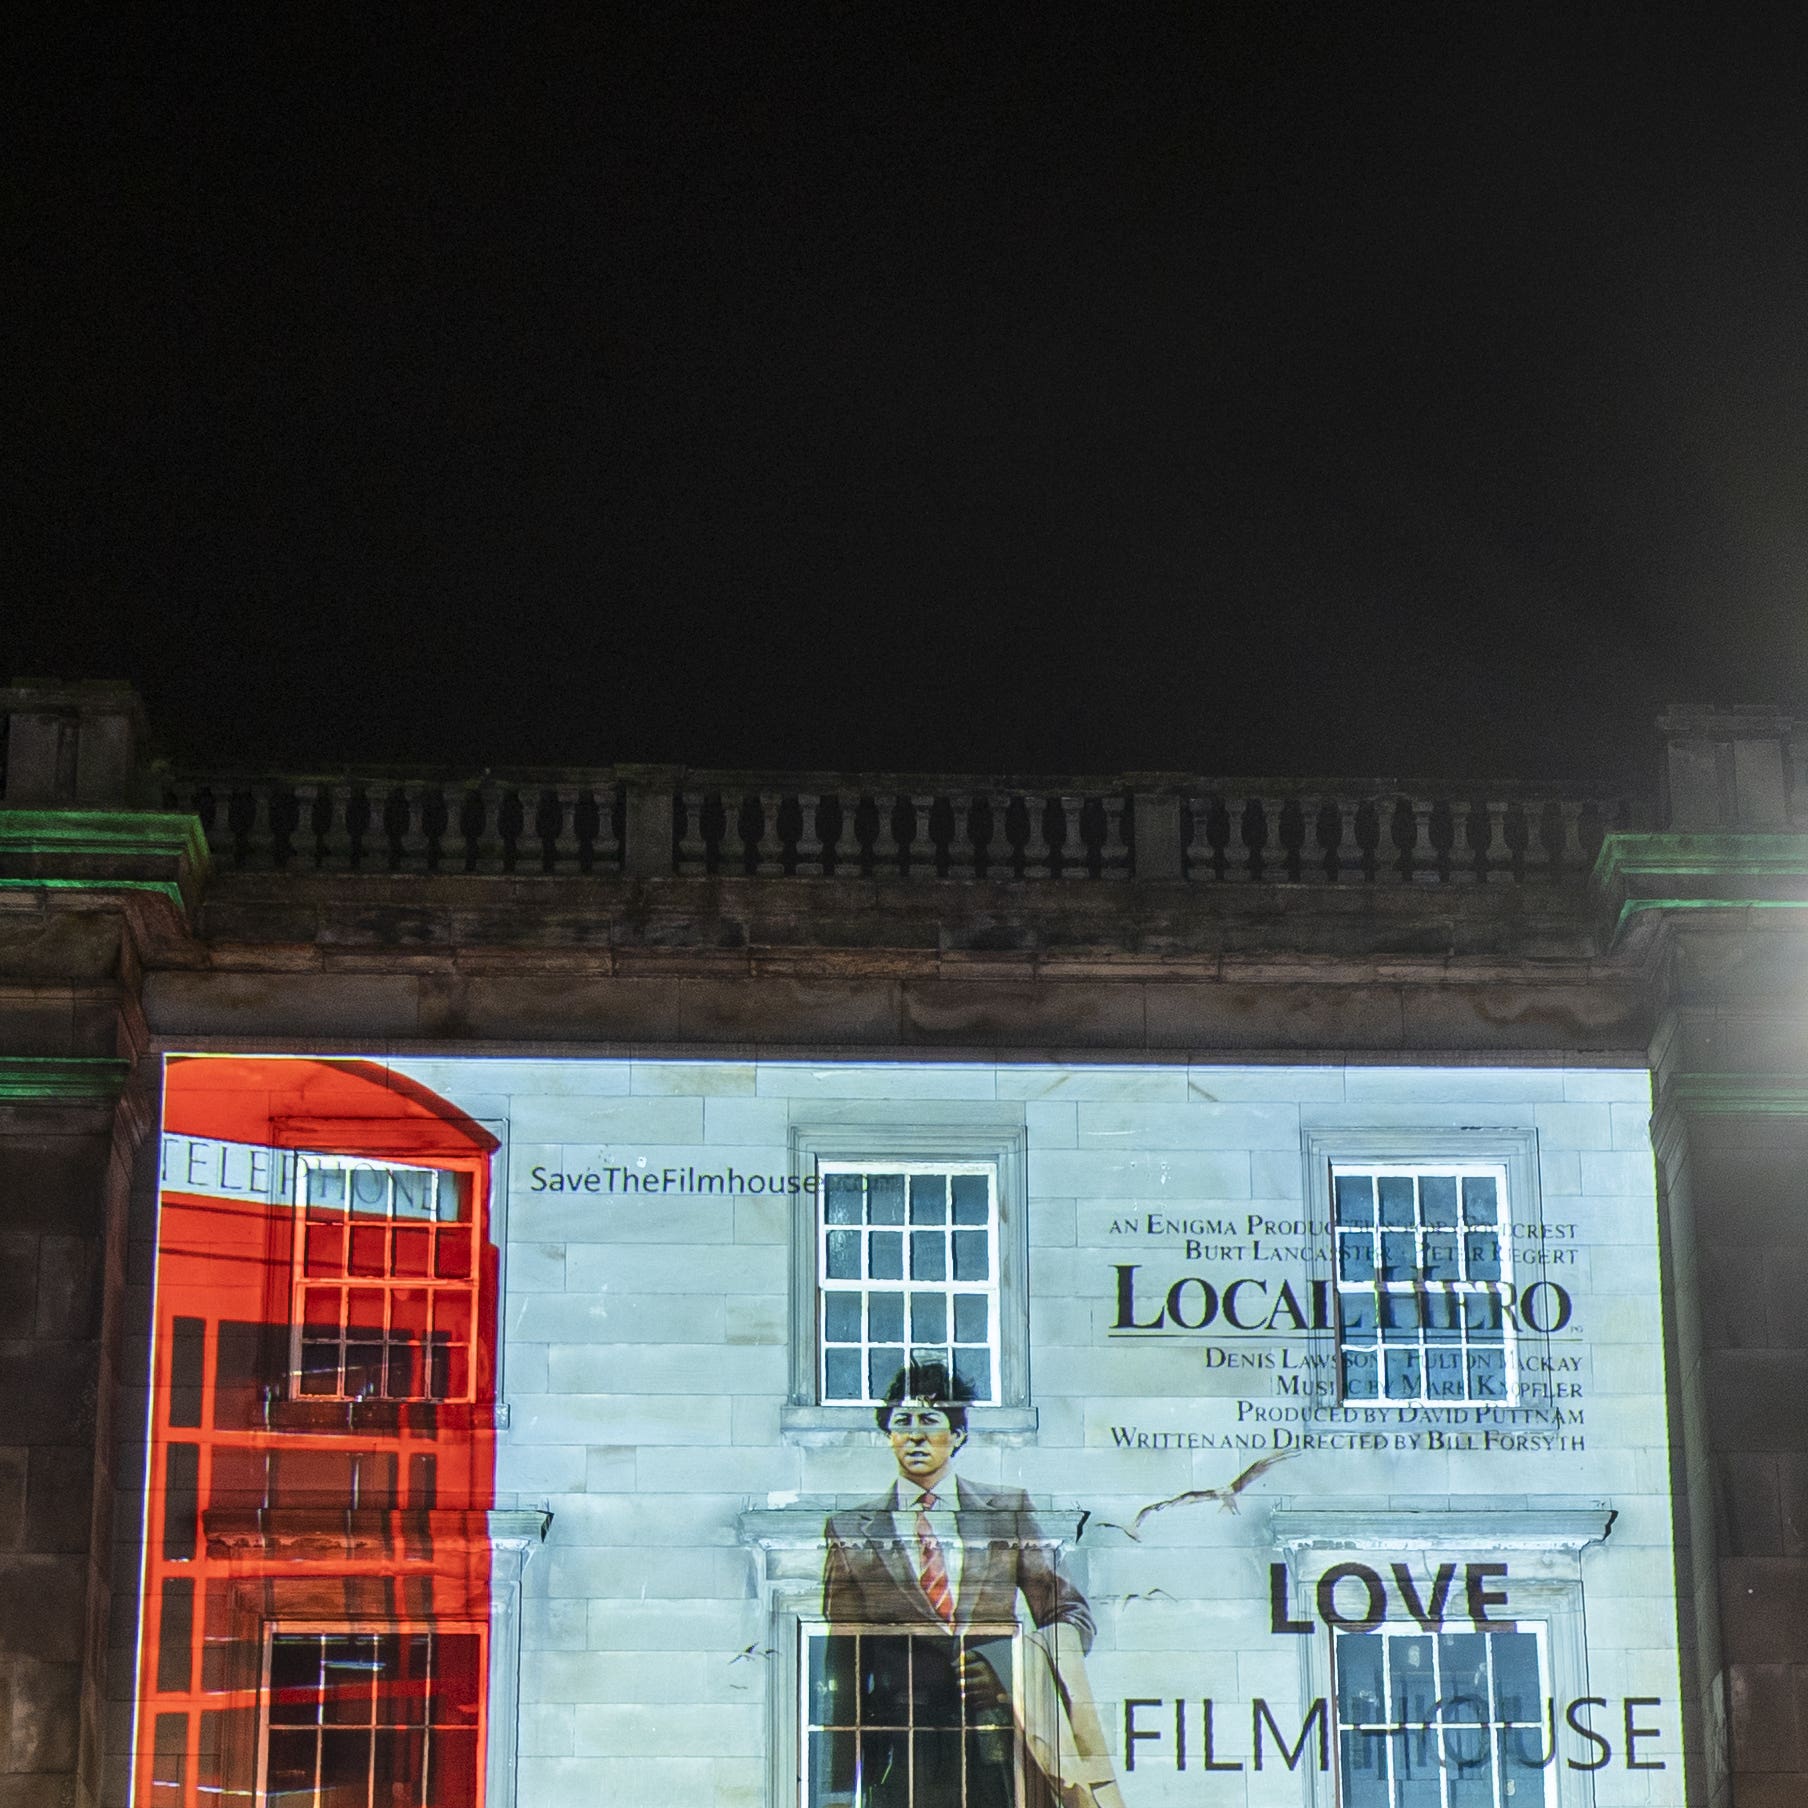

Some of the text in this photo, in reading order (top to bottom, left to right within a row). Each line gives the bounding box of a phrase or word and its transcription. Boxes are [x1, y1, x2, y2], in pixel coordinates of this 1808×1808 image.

[1147, 1214, 1238, 1236] ENIGMA
[1185, 1240, 1245, 1262] BURT
[1109, 1264, 1364, 1331] LOCAL
[1205, 1347, 1277, 1371] DENIS
[1237, 1401, 1586, 1426] PRODUCED BY DAVID PUTTNAM
[1111, 1427, 1587, 1453] WRITTEN AND DIRECTED BY BILL FORSYTH
[1269, 1562, 1517, 1635] LOVE
